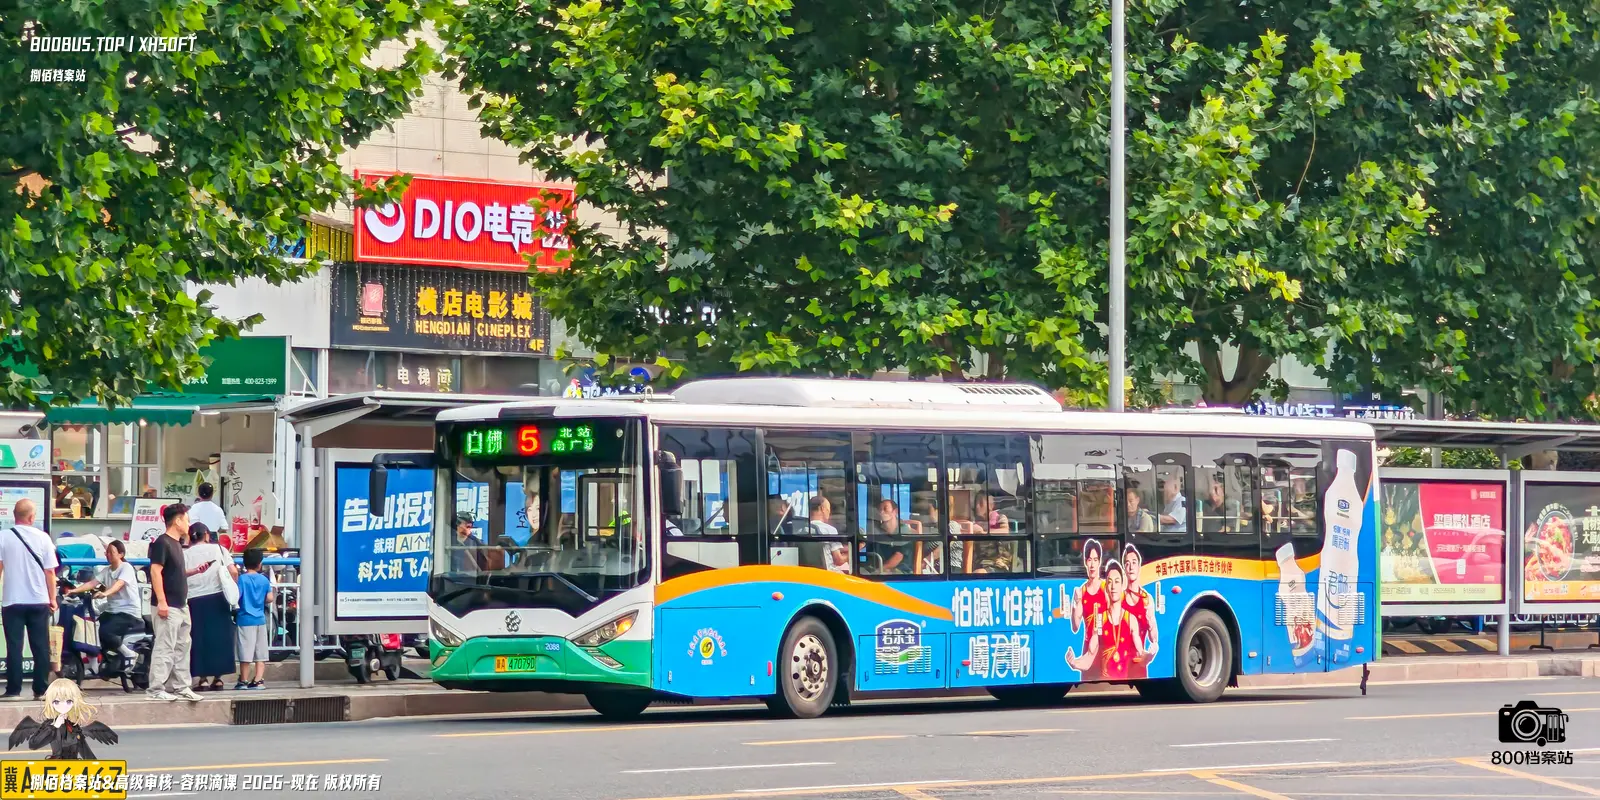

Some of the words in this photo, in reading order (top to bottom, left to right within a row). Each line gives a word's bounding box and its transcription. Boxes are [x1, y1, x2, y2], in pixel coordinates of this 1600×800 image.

[417, 286, 533, 320] 横店电影城
[415, 320, 471, 336] HENGDIAN
[477, 322, 531, 338] CINEPLEX
[528, 339, 545, 352] 4F
[397, 366, 453, 386] 电梯间
[519, 428, 539, 453] 5
[560, 427, 591, 438] 北站
[1155, 559, 1233, 577] 中国十大国家队官方合作伙伴
[882, 627, 916, 645] 君乐宝
[968, 632, 1031, 680] 喝君畅
